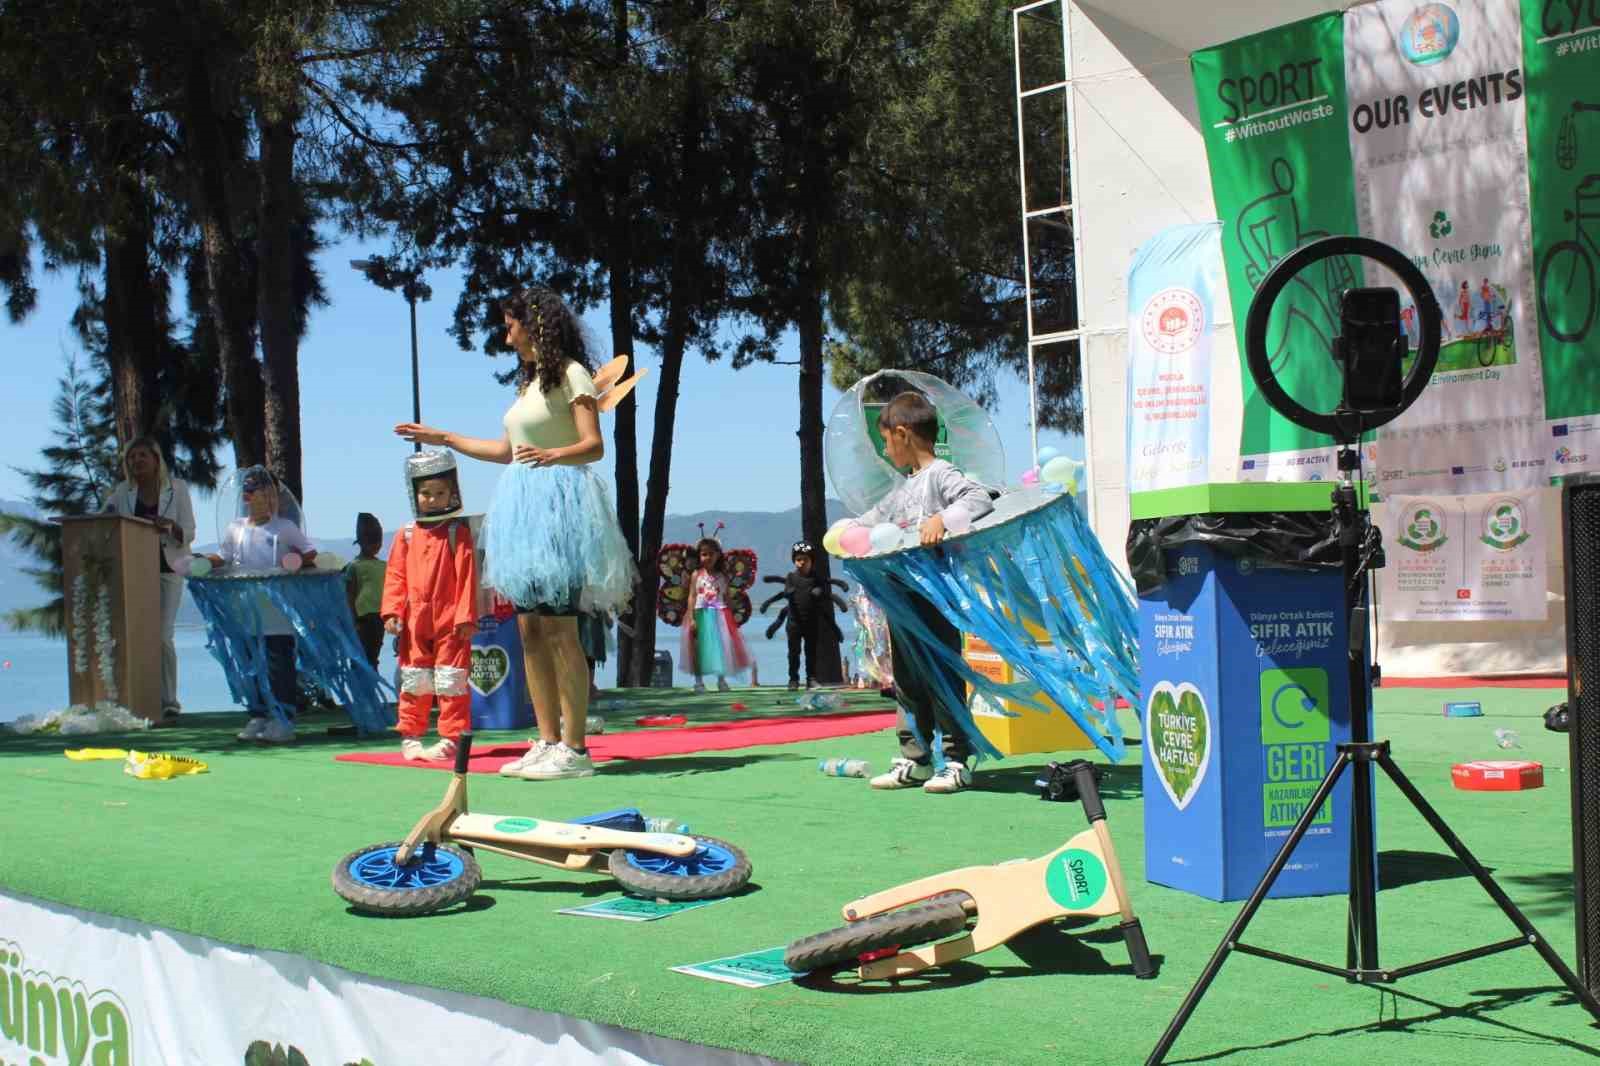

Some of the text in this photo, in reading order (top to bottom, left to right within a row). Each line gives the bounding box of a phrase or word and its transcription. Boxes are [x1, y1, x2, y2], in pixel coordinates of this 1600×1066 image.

[1556, 34, 1600, 57] #Wit
[1217, 58, 1322, 124] SPORT
[1353, 69, 1522, 133] OUR EVENTS
[1225, 104, 1334, 143] #WithoutWaste
[1154, 624, 1194, 640] SIFIR ATIK
[1250, 621, 1334, 638] SIFIR ATIK
[1158, 711, 1197, 732] TÜRKİYE
[1163, 731, 1193, 749] ÇEVRE
[1160, 748, 1199, 767] HAFTASI
[1069, 858, 1090, 896] SPORT
